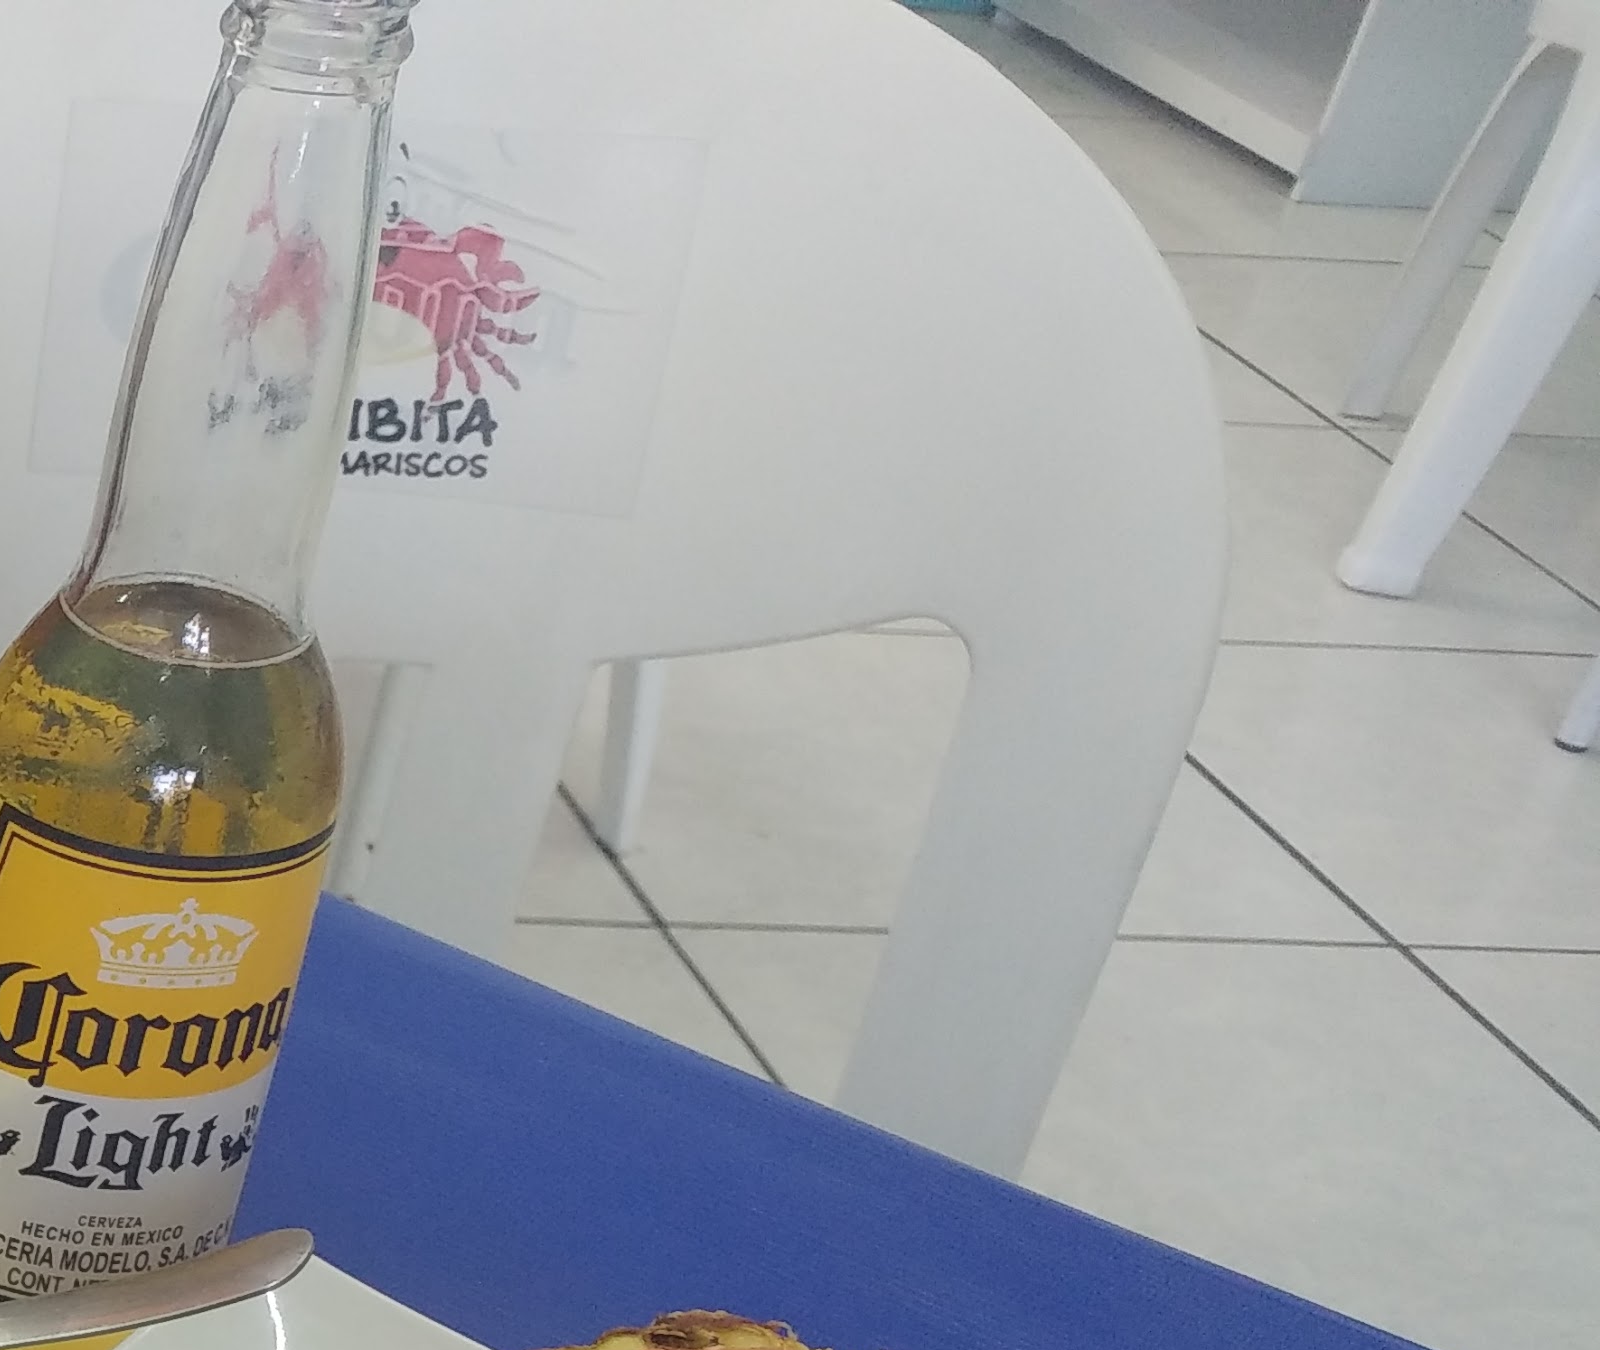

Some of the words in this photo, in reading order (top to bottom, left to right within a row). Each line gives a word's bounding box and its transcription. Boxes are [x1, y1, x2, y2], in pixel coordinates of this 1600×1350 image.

[347, 397, 498, 447] IBITA
[17, 1094, 220, 1191] Light
[20, 1219, 85, 1245] HECHO
[90, 1231, 116, 1247] EN
[121, 1225, 184, 1247] MEXICO
[77, 1214, 143, 1229] CERVEZA
